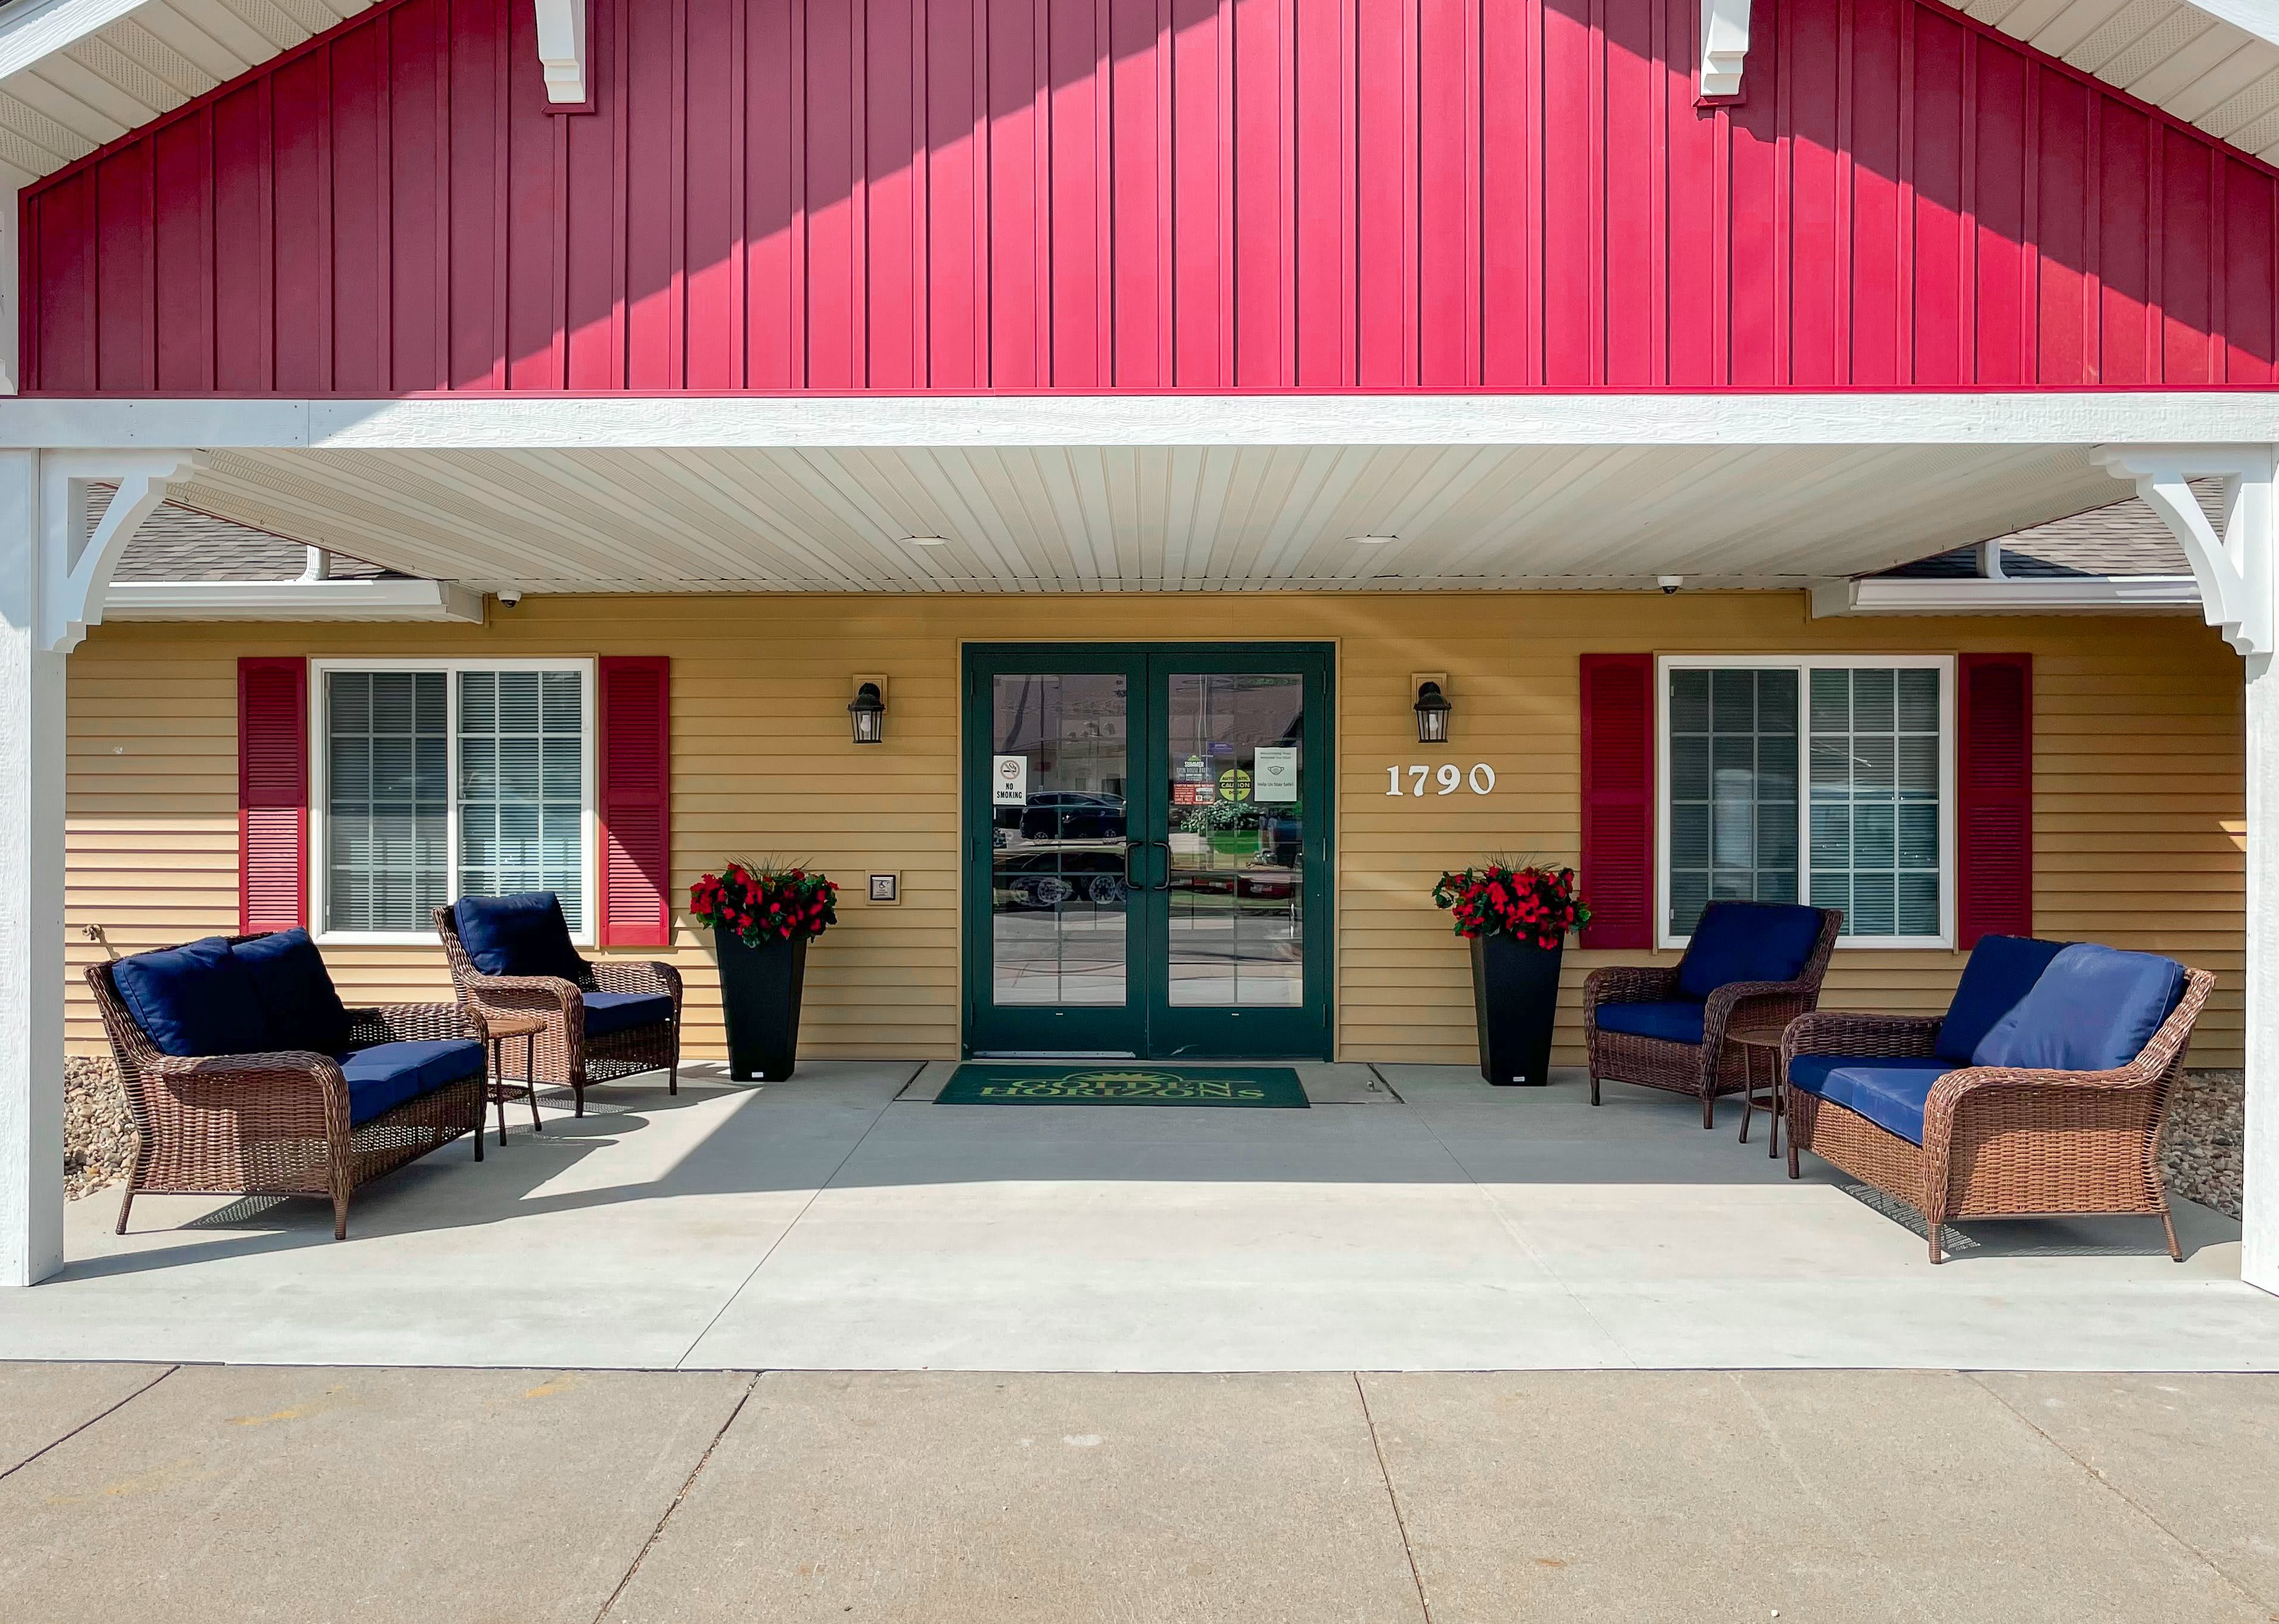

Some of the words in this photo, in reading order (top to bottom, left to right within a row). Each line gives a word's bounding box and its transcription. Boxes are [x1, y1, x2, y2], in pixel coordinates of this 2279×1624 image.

[1386, 762, 1496, 797] 1790
[1012, 1080, 1230, 1090] GOLDEN
[980, 1087, 1265, 1098] HORIZONS
